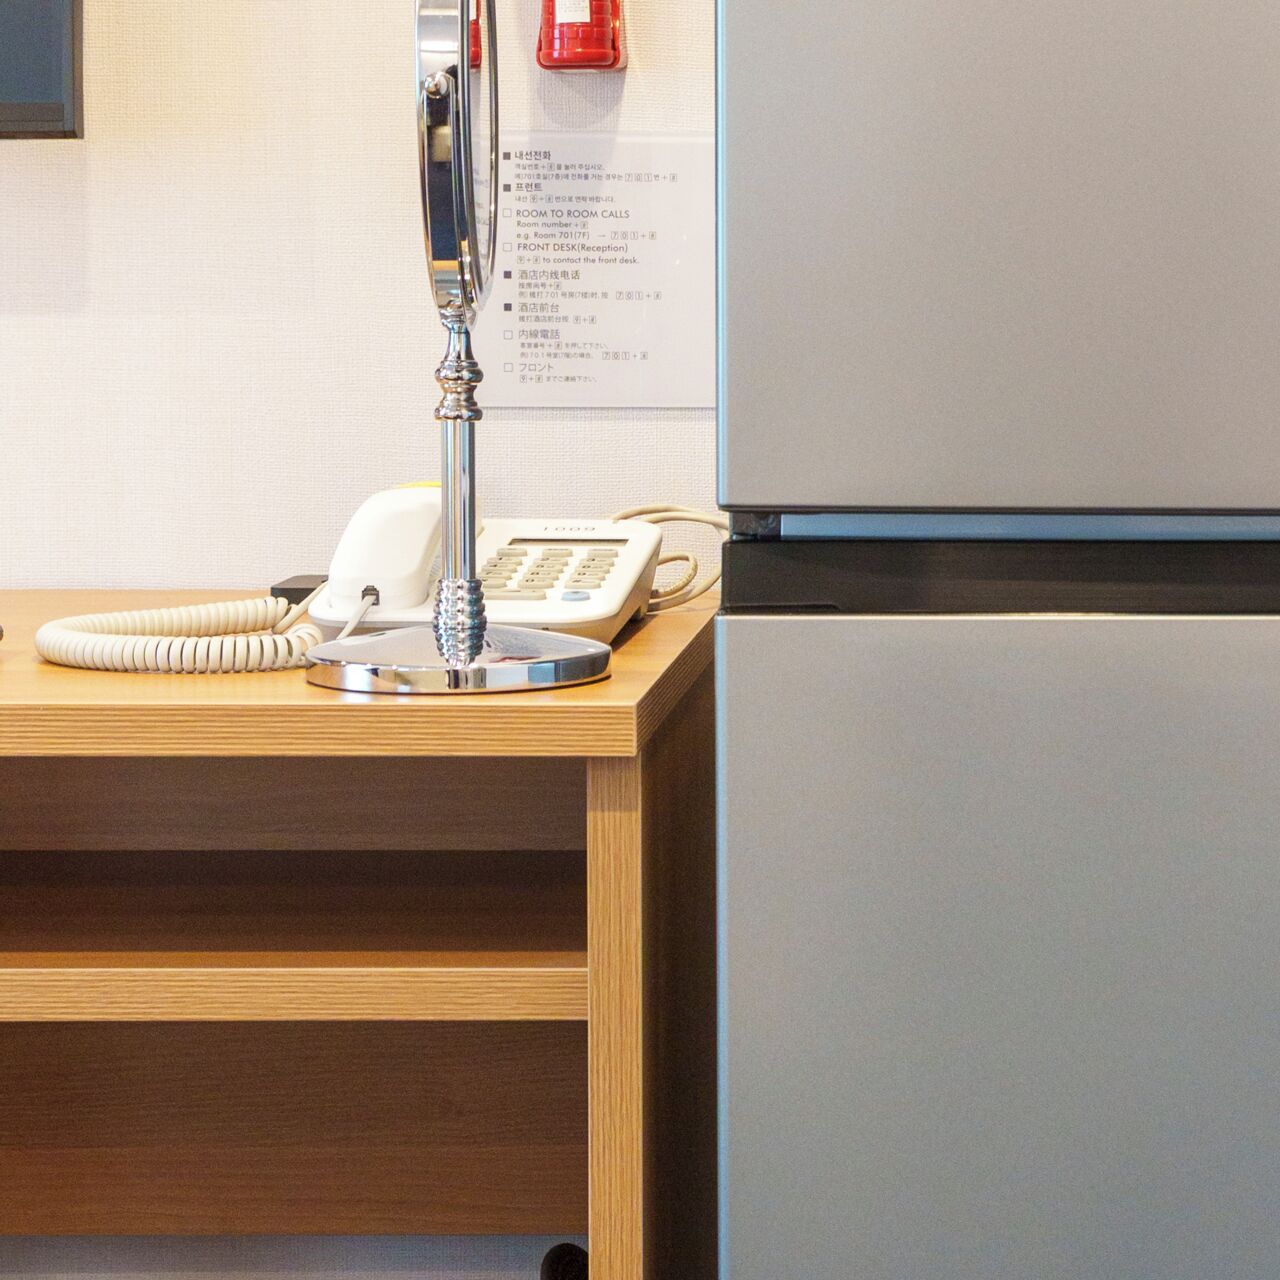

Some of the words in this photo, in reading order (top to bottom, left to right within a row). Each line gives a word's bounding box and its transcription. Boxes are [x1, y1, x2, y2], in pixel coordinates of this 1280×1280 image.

[514, 150, 551, 161] 내선전화
[515, 182, 543, 192] 프런트
[516, 210, 547, 218] ROOM
[551, 210, 563, 218] TO
[567, 210, 598, 218] ROOM
[601, 210, 630, 218] CALLS
[534, 231, 556, 239] Room
[517, 243, 550, 252] FRONT
[553, 243, 628, 253] DESK(Reception)
[583, 256, 596, 264] the
[598, 256, 617, 264] front
[518, 269, 581, 280] 酒店内线电话
[518, 302, 559, 313] 酒店前台
[518, 329, 560, 340] 内線電話
[519, 363, 554, 372] フロント
